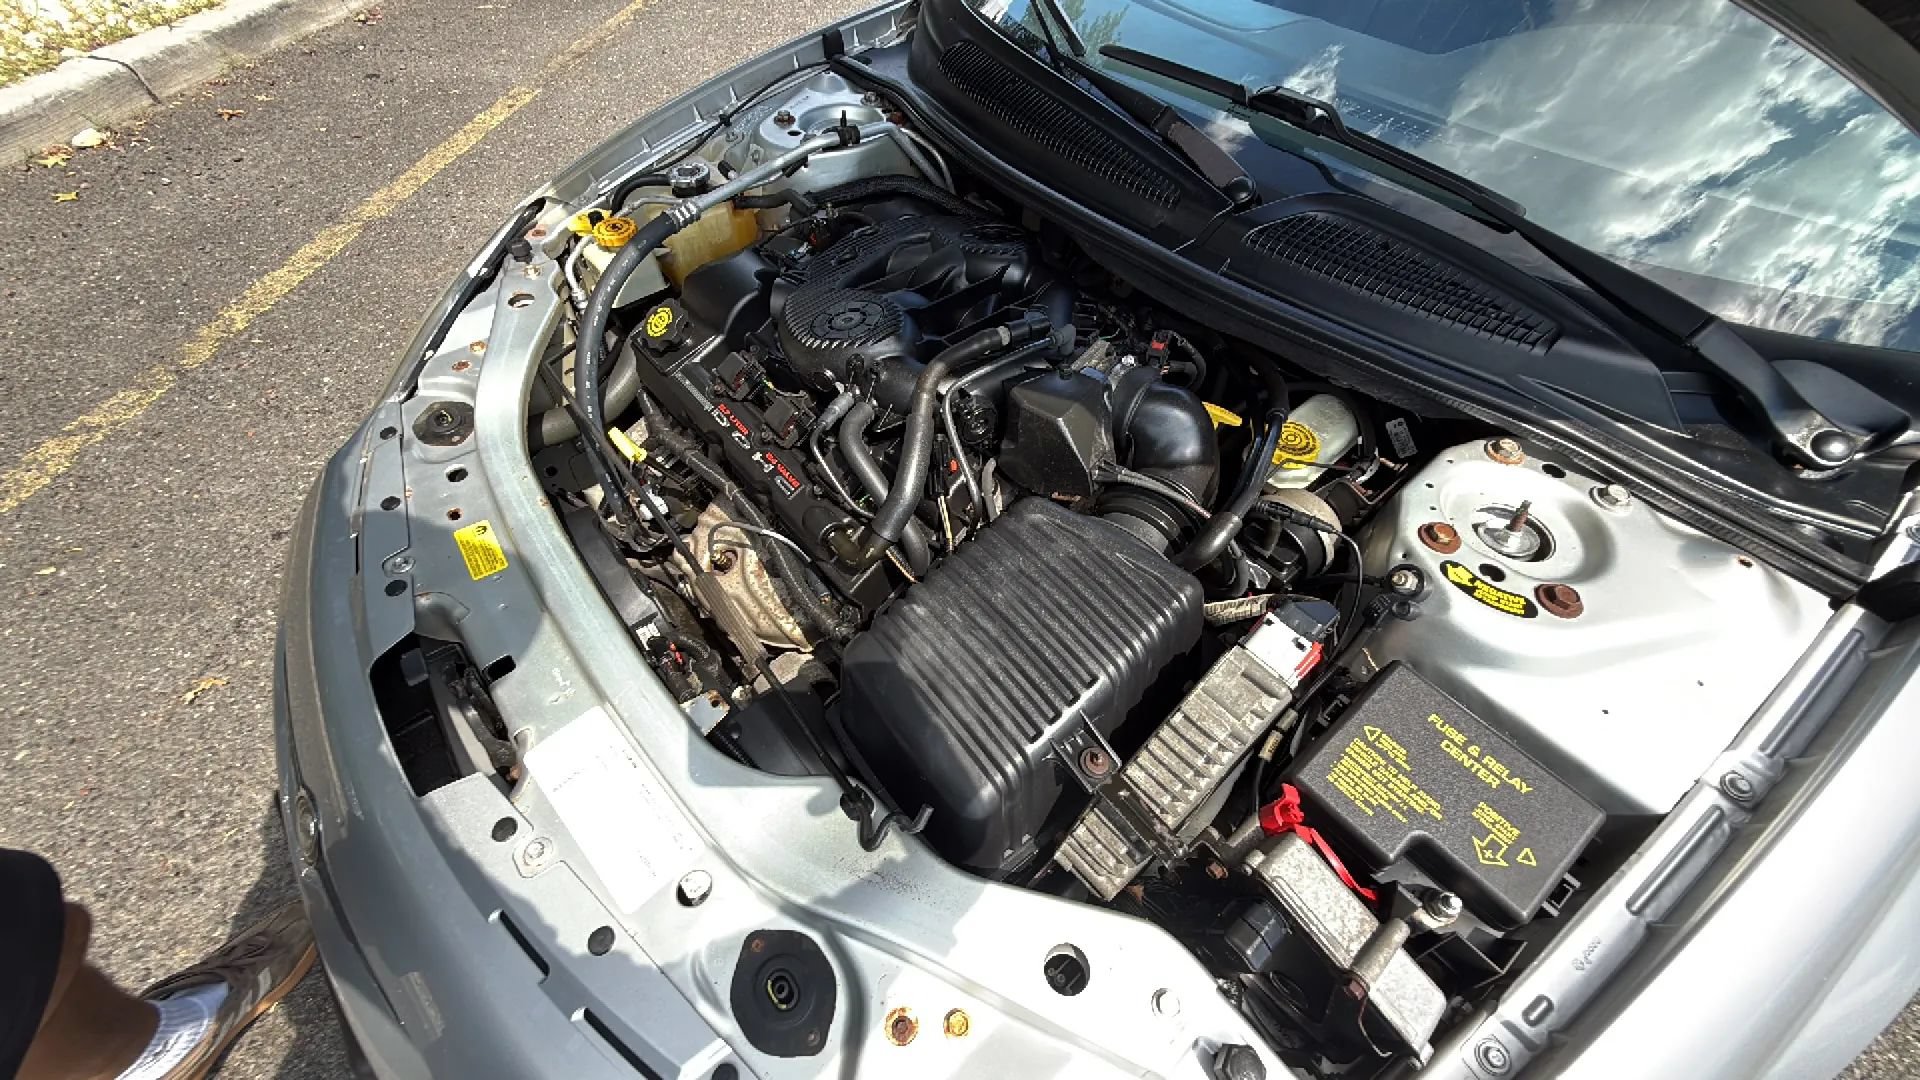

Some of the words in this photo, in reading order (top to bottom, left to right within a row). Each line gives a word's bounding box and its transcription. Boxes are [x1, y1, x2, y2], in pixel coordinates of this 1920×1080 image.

[777, 463, 801, 488] VALVE
[1428, 714, 1468, 746] FUSE
[1466, 746, 1481, 759] &
[1482, 755, 1534, 794] RELAY
[1441, 740, 1501, 788] CENTER
[1377, 765, 1412, 794] DAMAGE
[1386, 765, 1398, 776] TO
[1416, 791, 1440, 811] AVOID
[1477, 802, 1521, 838] POSITIVE
